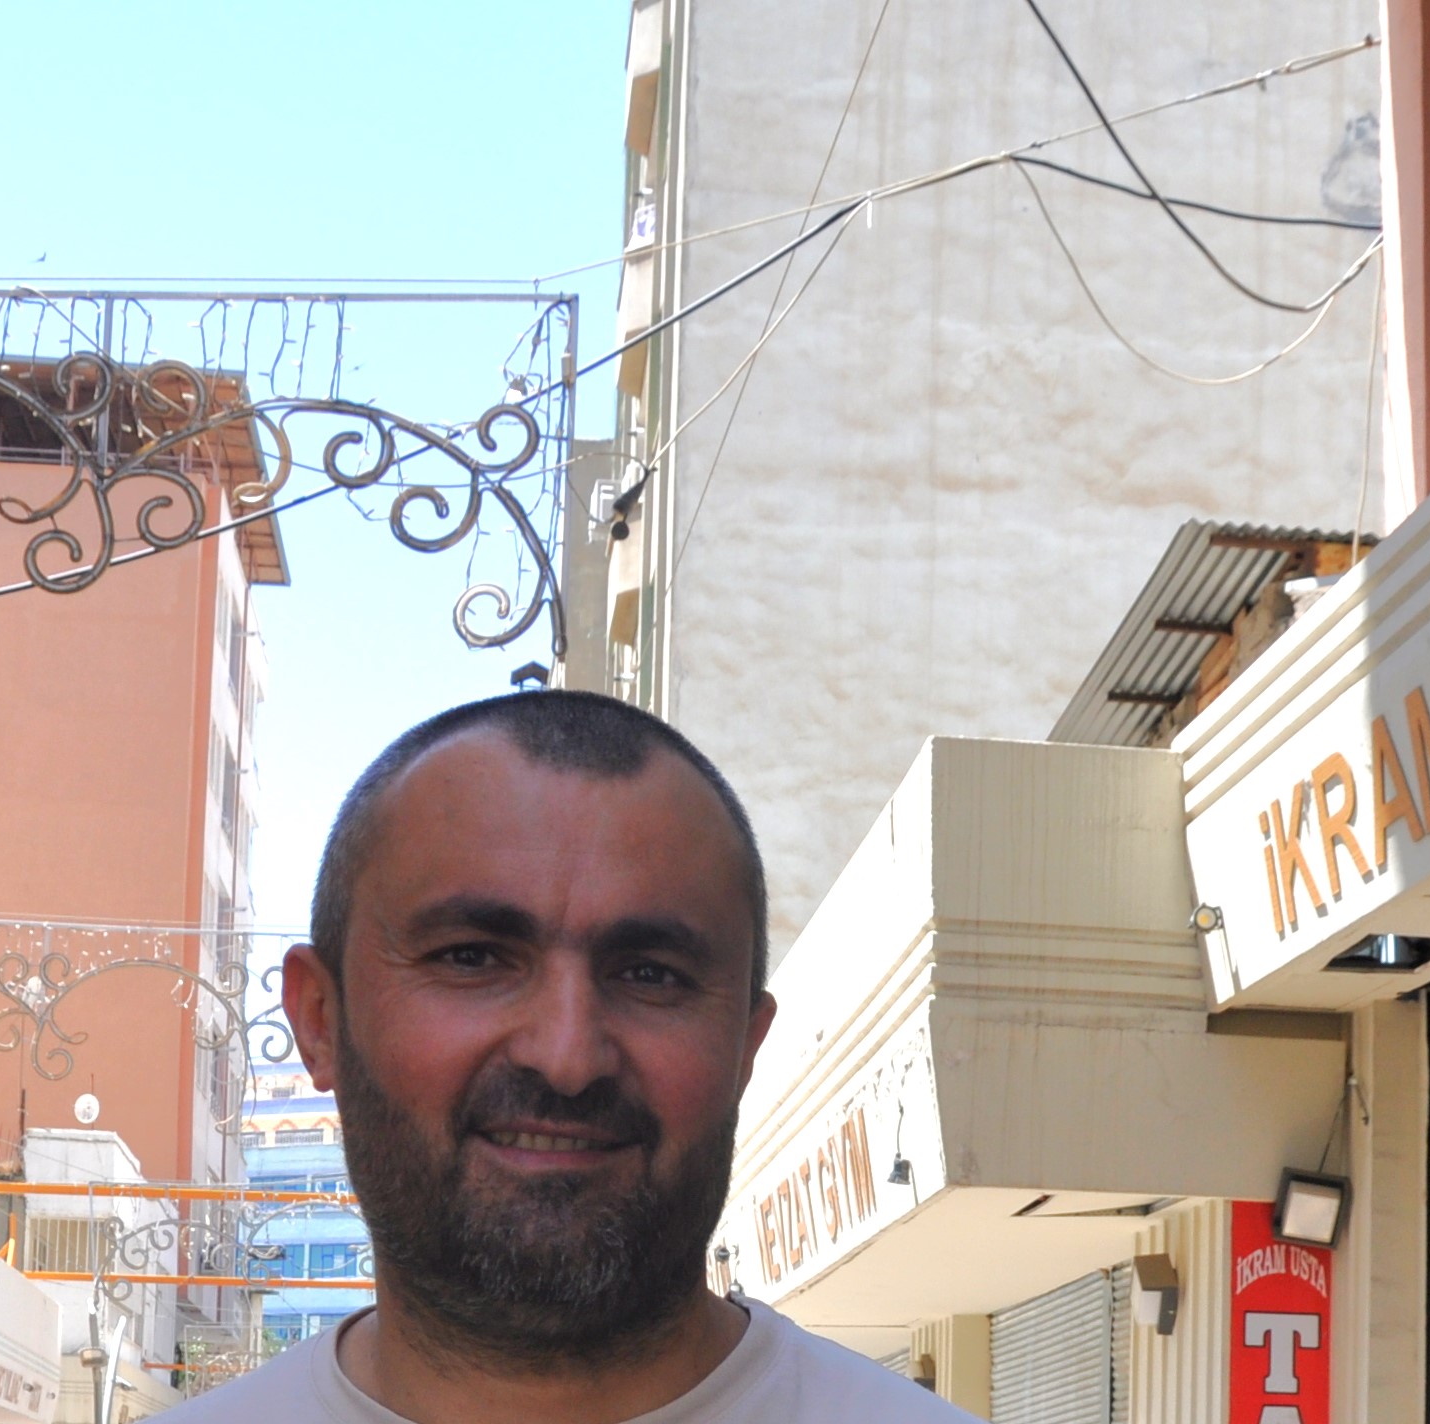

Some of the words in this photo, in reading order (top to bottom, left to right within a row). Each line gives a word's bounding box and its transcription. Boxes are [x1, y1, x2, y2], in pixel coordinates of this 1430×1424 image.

[753, 1156, 819, 1286] EVZAT
[1235, 1244, 1287, 1296] İKRAM
[1289, 1244, 1328, 1299] USTA
